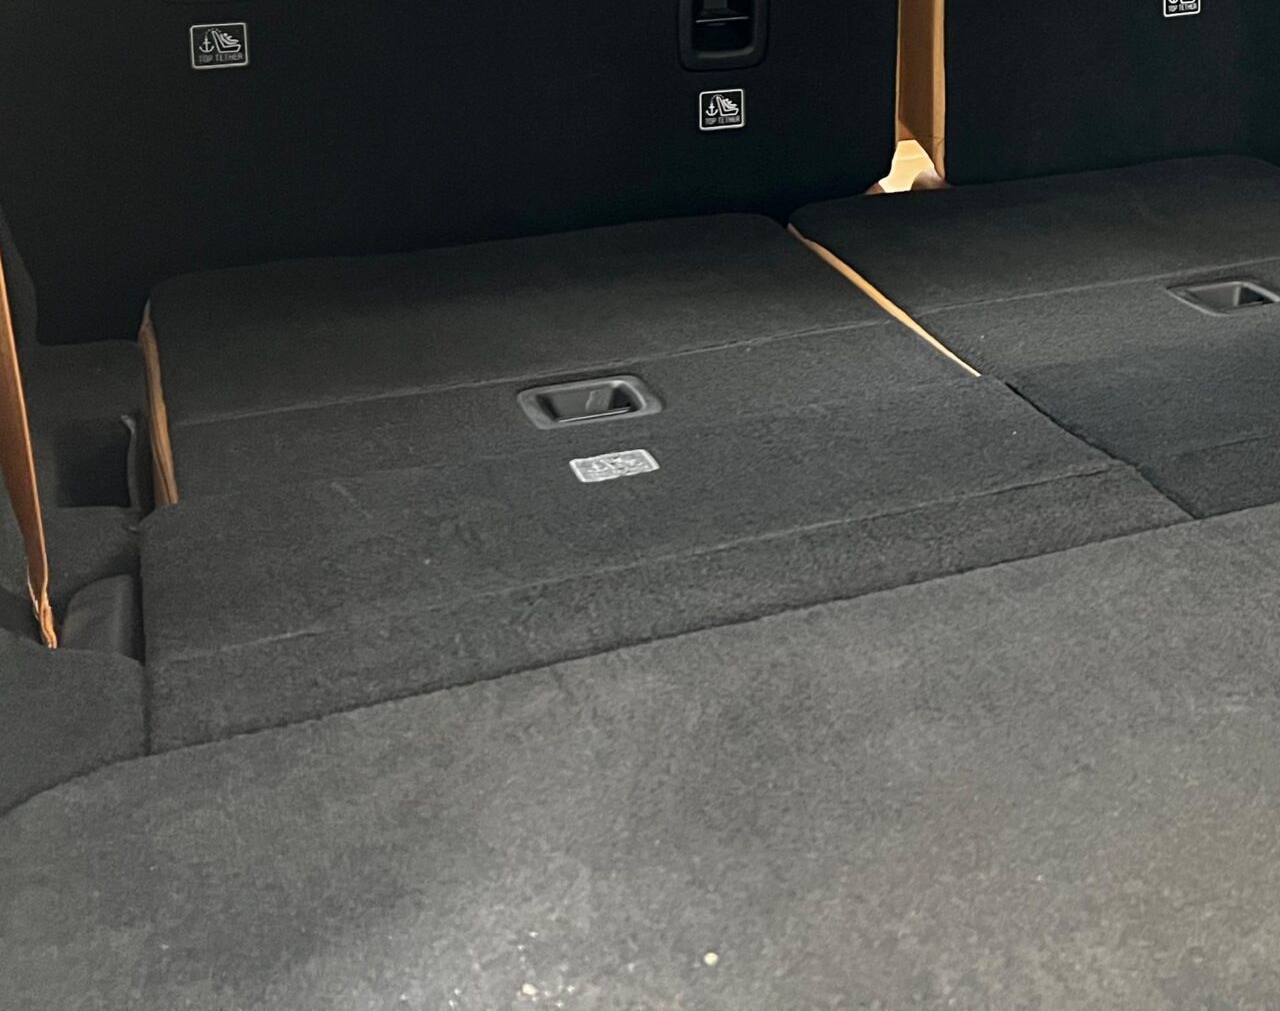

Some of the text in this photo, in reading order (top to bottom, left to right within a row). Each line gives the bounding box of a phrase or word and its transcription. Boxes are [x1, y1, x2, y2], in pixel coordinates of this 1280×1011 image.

[199, 51, 244, 63] TOP TETHER
[705, 117, 717, 125] TOP
